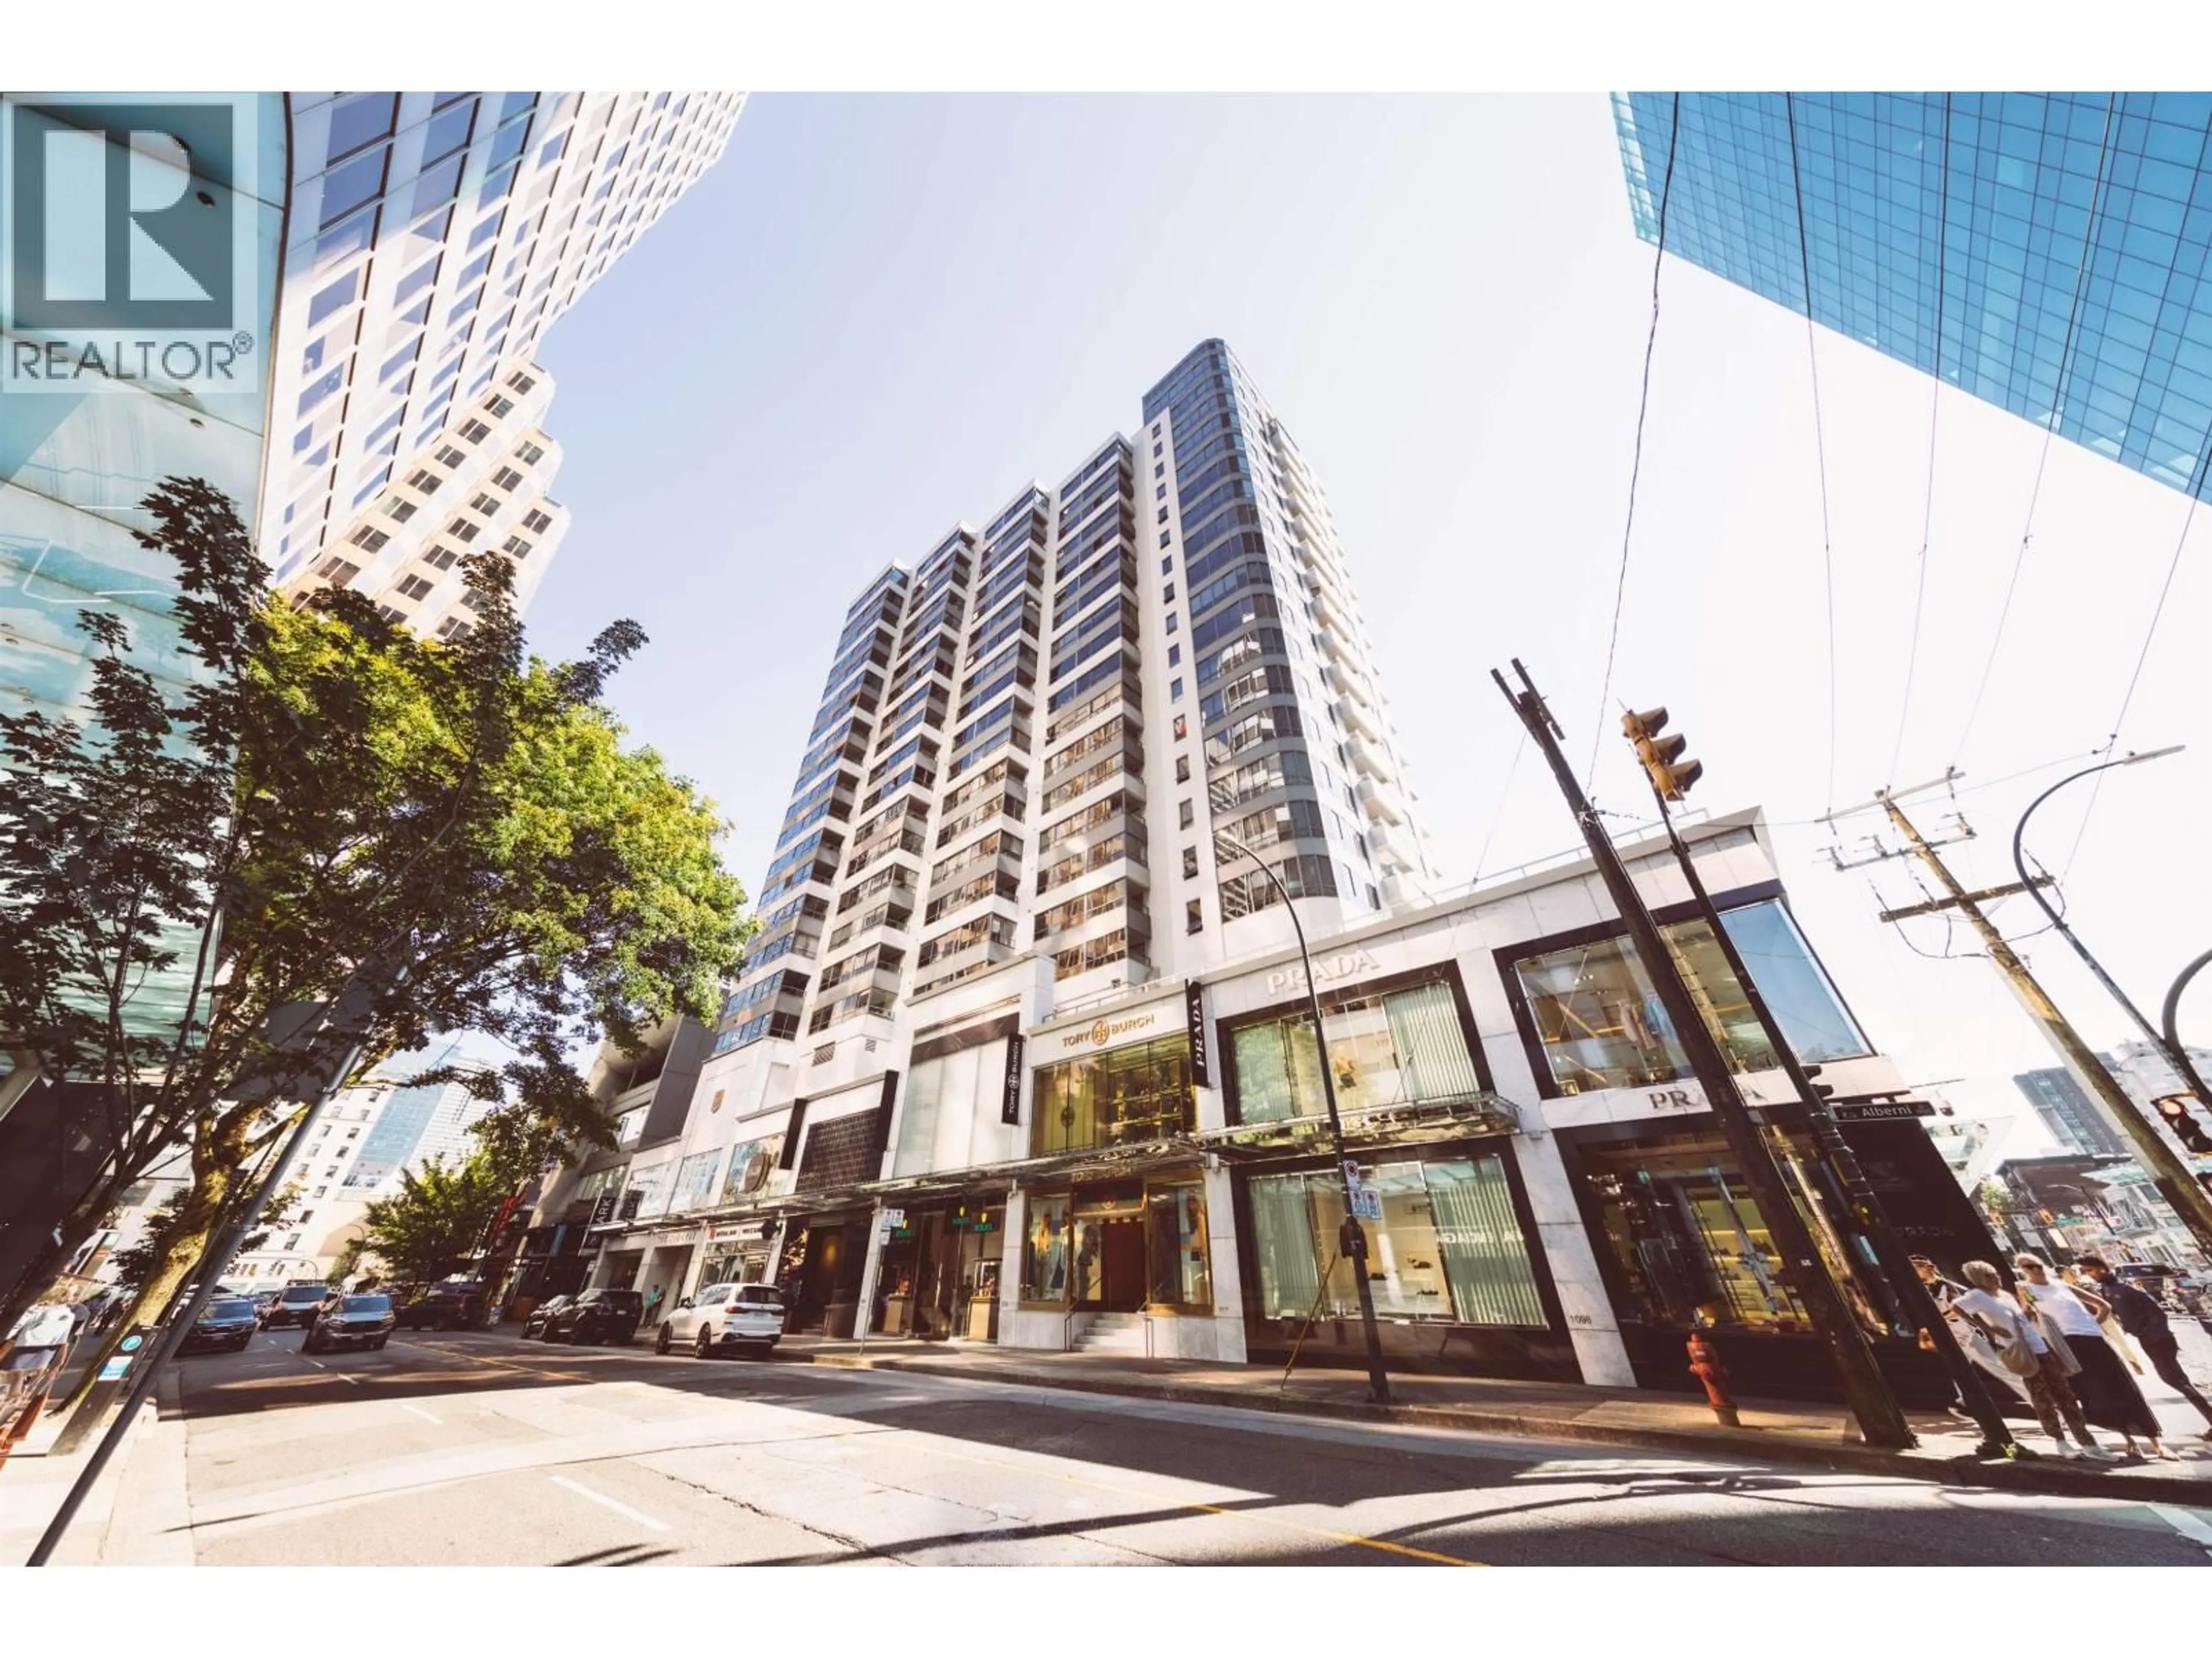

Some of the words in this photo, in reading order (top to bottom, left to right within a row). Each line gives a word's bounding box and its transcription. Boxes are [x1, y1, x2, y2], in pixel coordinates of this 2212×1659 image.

[1267, 949, 1380, 996] PRADA
[1062, 1030, 1090, 1047] TORY
[1111, 1014, 1155, 1035] BURCH
[1192, 999, 1205, 1066] PRADA
[1862, 1105, 1912, 1117] Alberni
[596, 1199, 612, 1225] ARK
